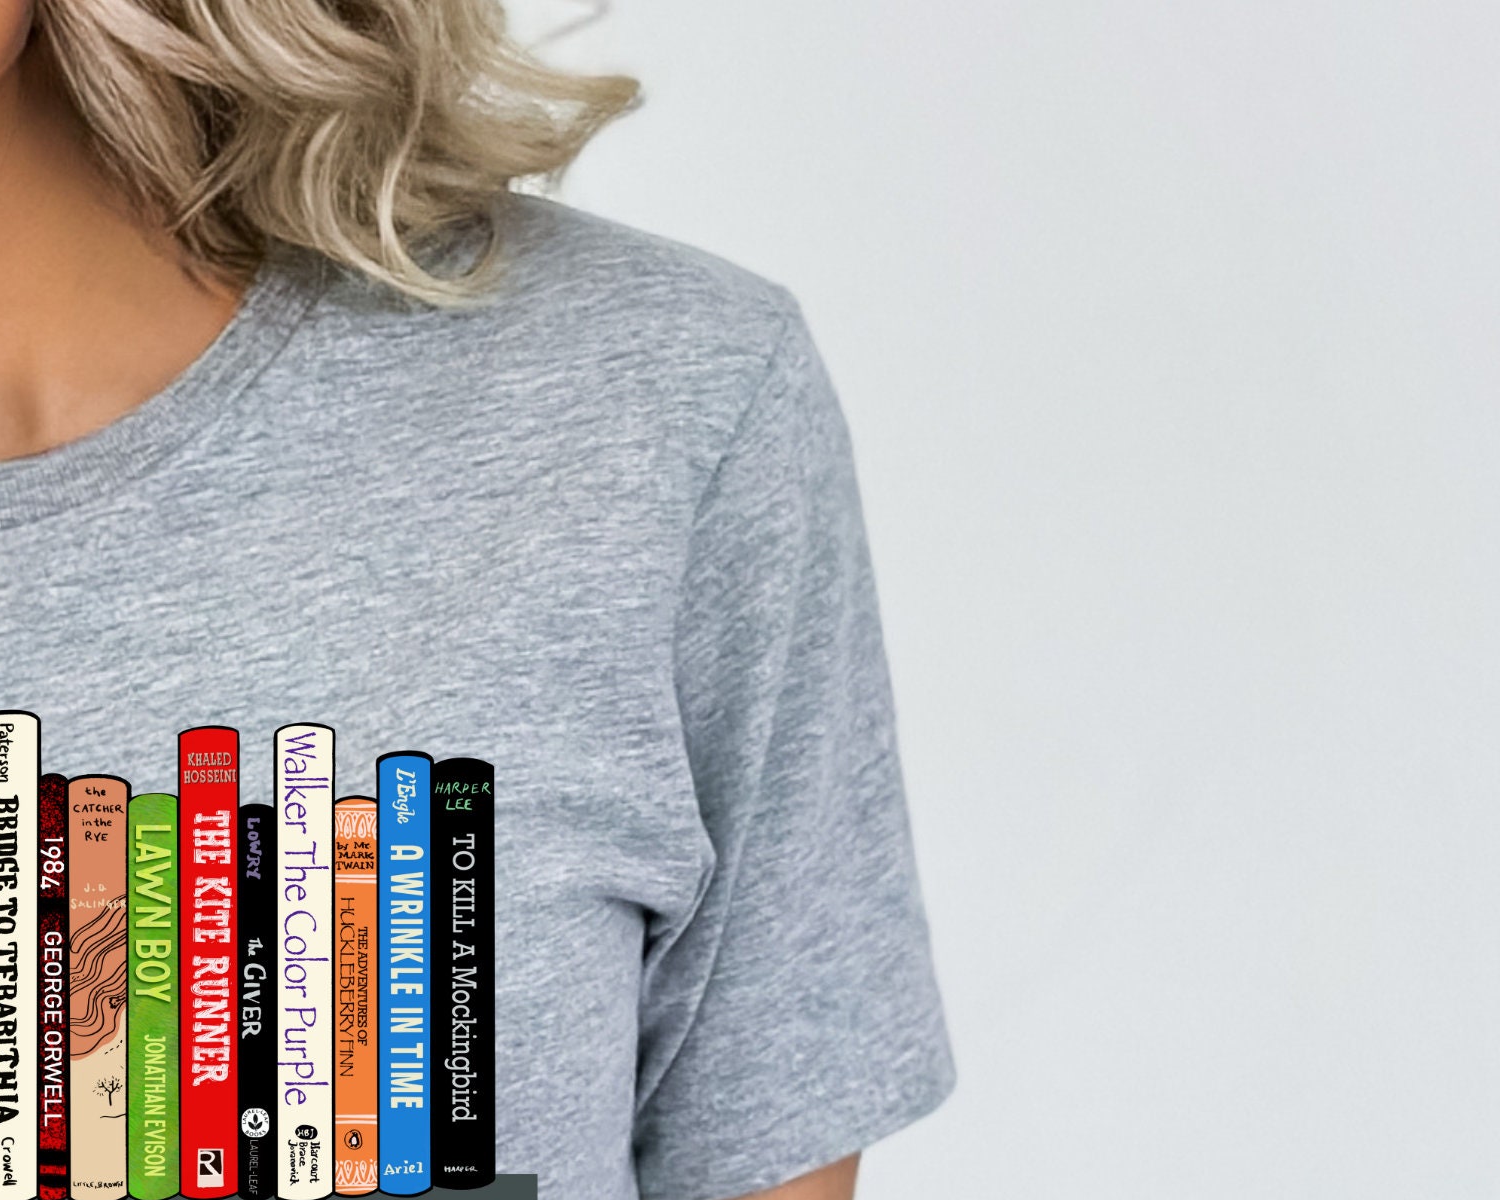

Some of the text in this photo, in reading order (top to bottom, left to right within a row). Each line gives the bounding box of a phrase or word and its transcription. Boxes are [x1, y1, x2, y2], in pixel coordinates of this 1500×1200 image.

[184, 769, 237, 784] HOSSEINI
[188, 752, 232, 766] KHALED
[84, 786, 107, 798] the
[392, 768, 416, 824] L'Engle
[434, 781, 492, 795] HARPER
[445, 797, 473, 811] LEE
[72, 803, 125, 814] CATCHER
[81, 817, 113, 828] in the
[84, 830, 109, 843] RYE
[246, 818, 262, 879] LOWRY
[336, 841, 349, 851] by
[338, 851, 375, 860] MARK
[40, 836, 64, 890] 1984
[335, 860, 375, 871] TWAIN
[135, 824, 171, 1003] LAWN BOY
[278, 732, 329, 1105] Walker The Color Purple
[191, 810, 232, 1086] THE KITE RUNNER
[242, 938, 267, 1039] The GIVER
[340, 898, 355, 1076] HUCKLEBERRY FINN
[357, 926, 369, 1047] THE ADVENTURES OF
[390, 845, 425, 1108] A WRINKLE IN TIME
[444, 834, 477, 1122] TO KILL A Mockingbird
[44, 931, 63, 1127] GEORGE ORWELL
[144, 1033, 166, 1177] JONATHAN EVISON
[1, 1137, 17, 1186] Crowell
[295, 1141, 309, 1168] Brace
[384, 1160, 423, 1175] Ariel
[443, 1165, 478, 1173] HARPER
